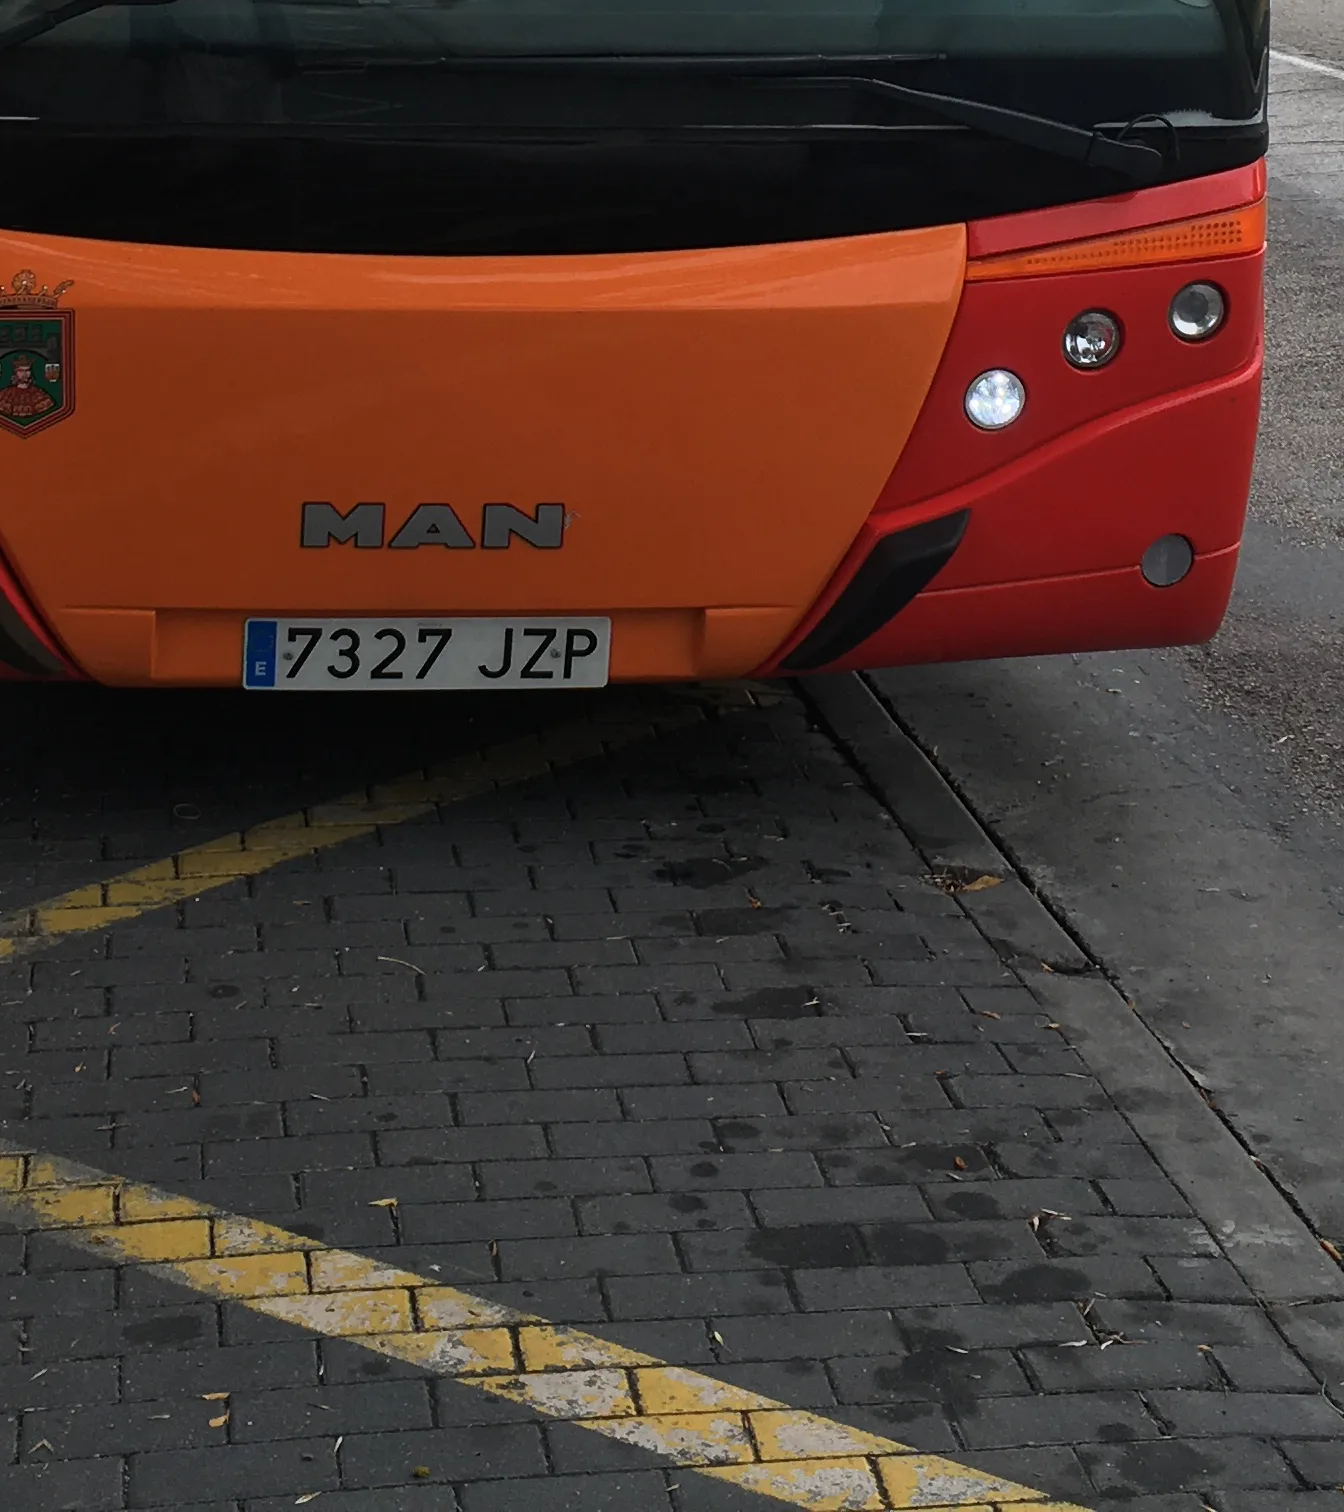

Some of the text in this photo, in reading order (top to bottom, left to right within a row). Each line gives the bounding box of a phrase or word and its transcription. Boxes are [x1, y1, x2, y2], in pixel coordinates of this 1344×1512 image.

[299, 501, 566, 550] MAN
[255, 627, 599, 680] E 7327 JZP
